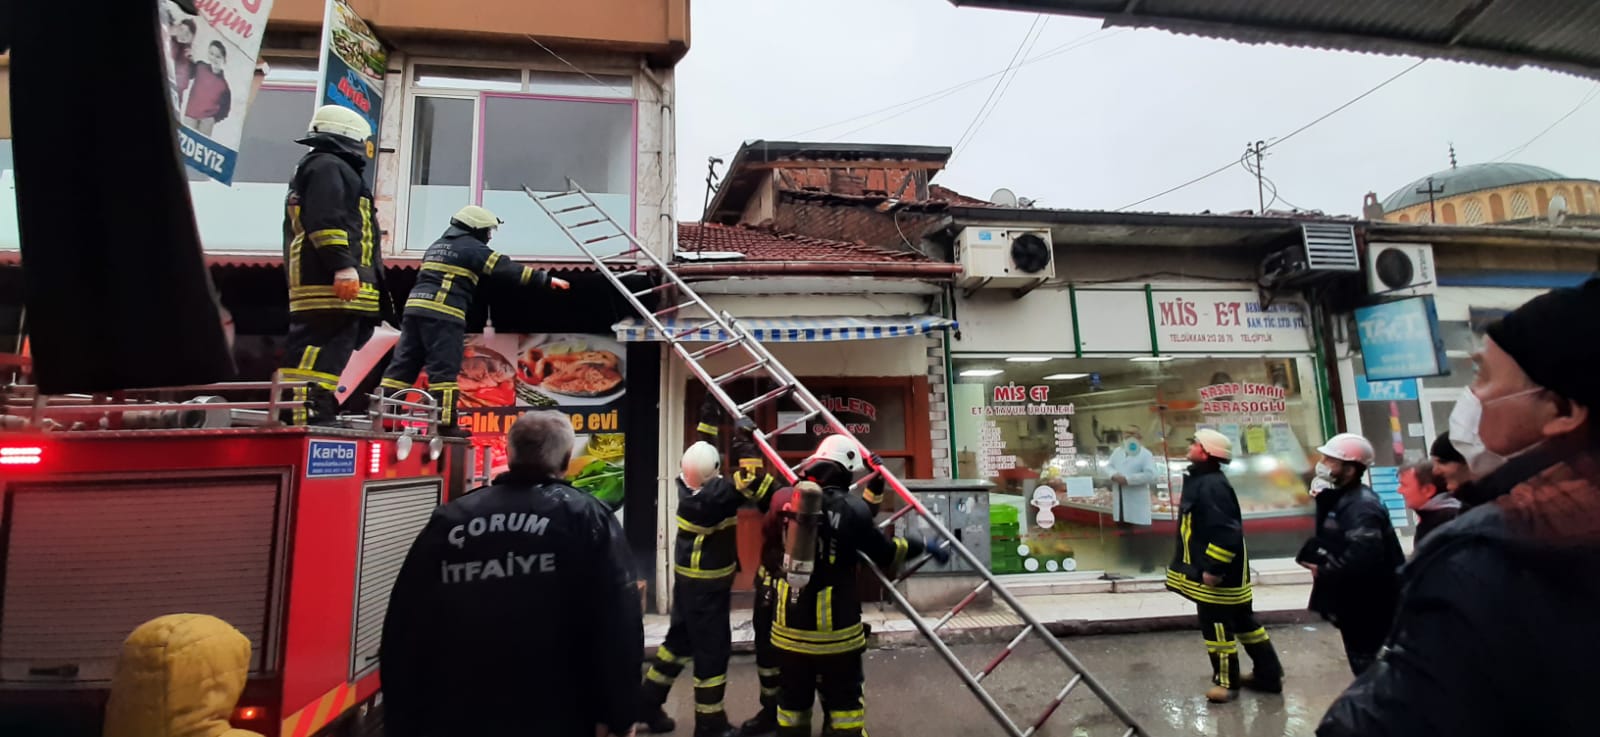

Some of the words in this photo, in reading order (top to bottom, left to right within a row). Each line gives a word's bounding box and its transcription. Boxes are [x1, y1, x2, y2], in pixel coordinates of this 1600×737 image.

[1158, 297, 1198, 327] MİS
[1214, 301, 1242, 327] ET
[993, 381, 1026, 402] MİS
[1029, 385, 1050, 402] ET
[1199, 383, 1240, 400] KASAP
[820, 395, 877, 420] ÜLER
[970, 406, 983, 416] ET
[587, 409, 618, 431] evi
[812, 423, 834, 436] ÇA
[312, 443, 354, 459] karba
[447, 512, 551, 549] ÇORUM
[441, 551, 556, 584] İTFAİYE
